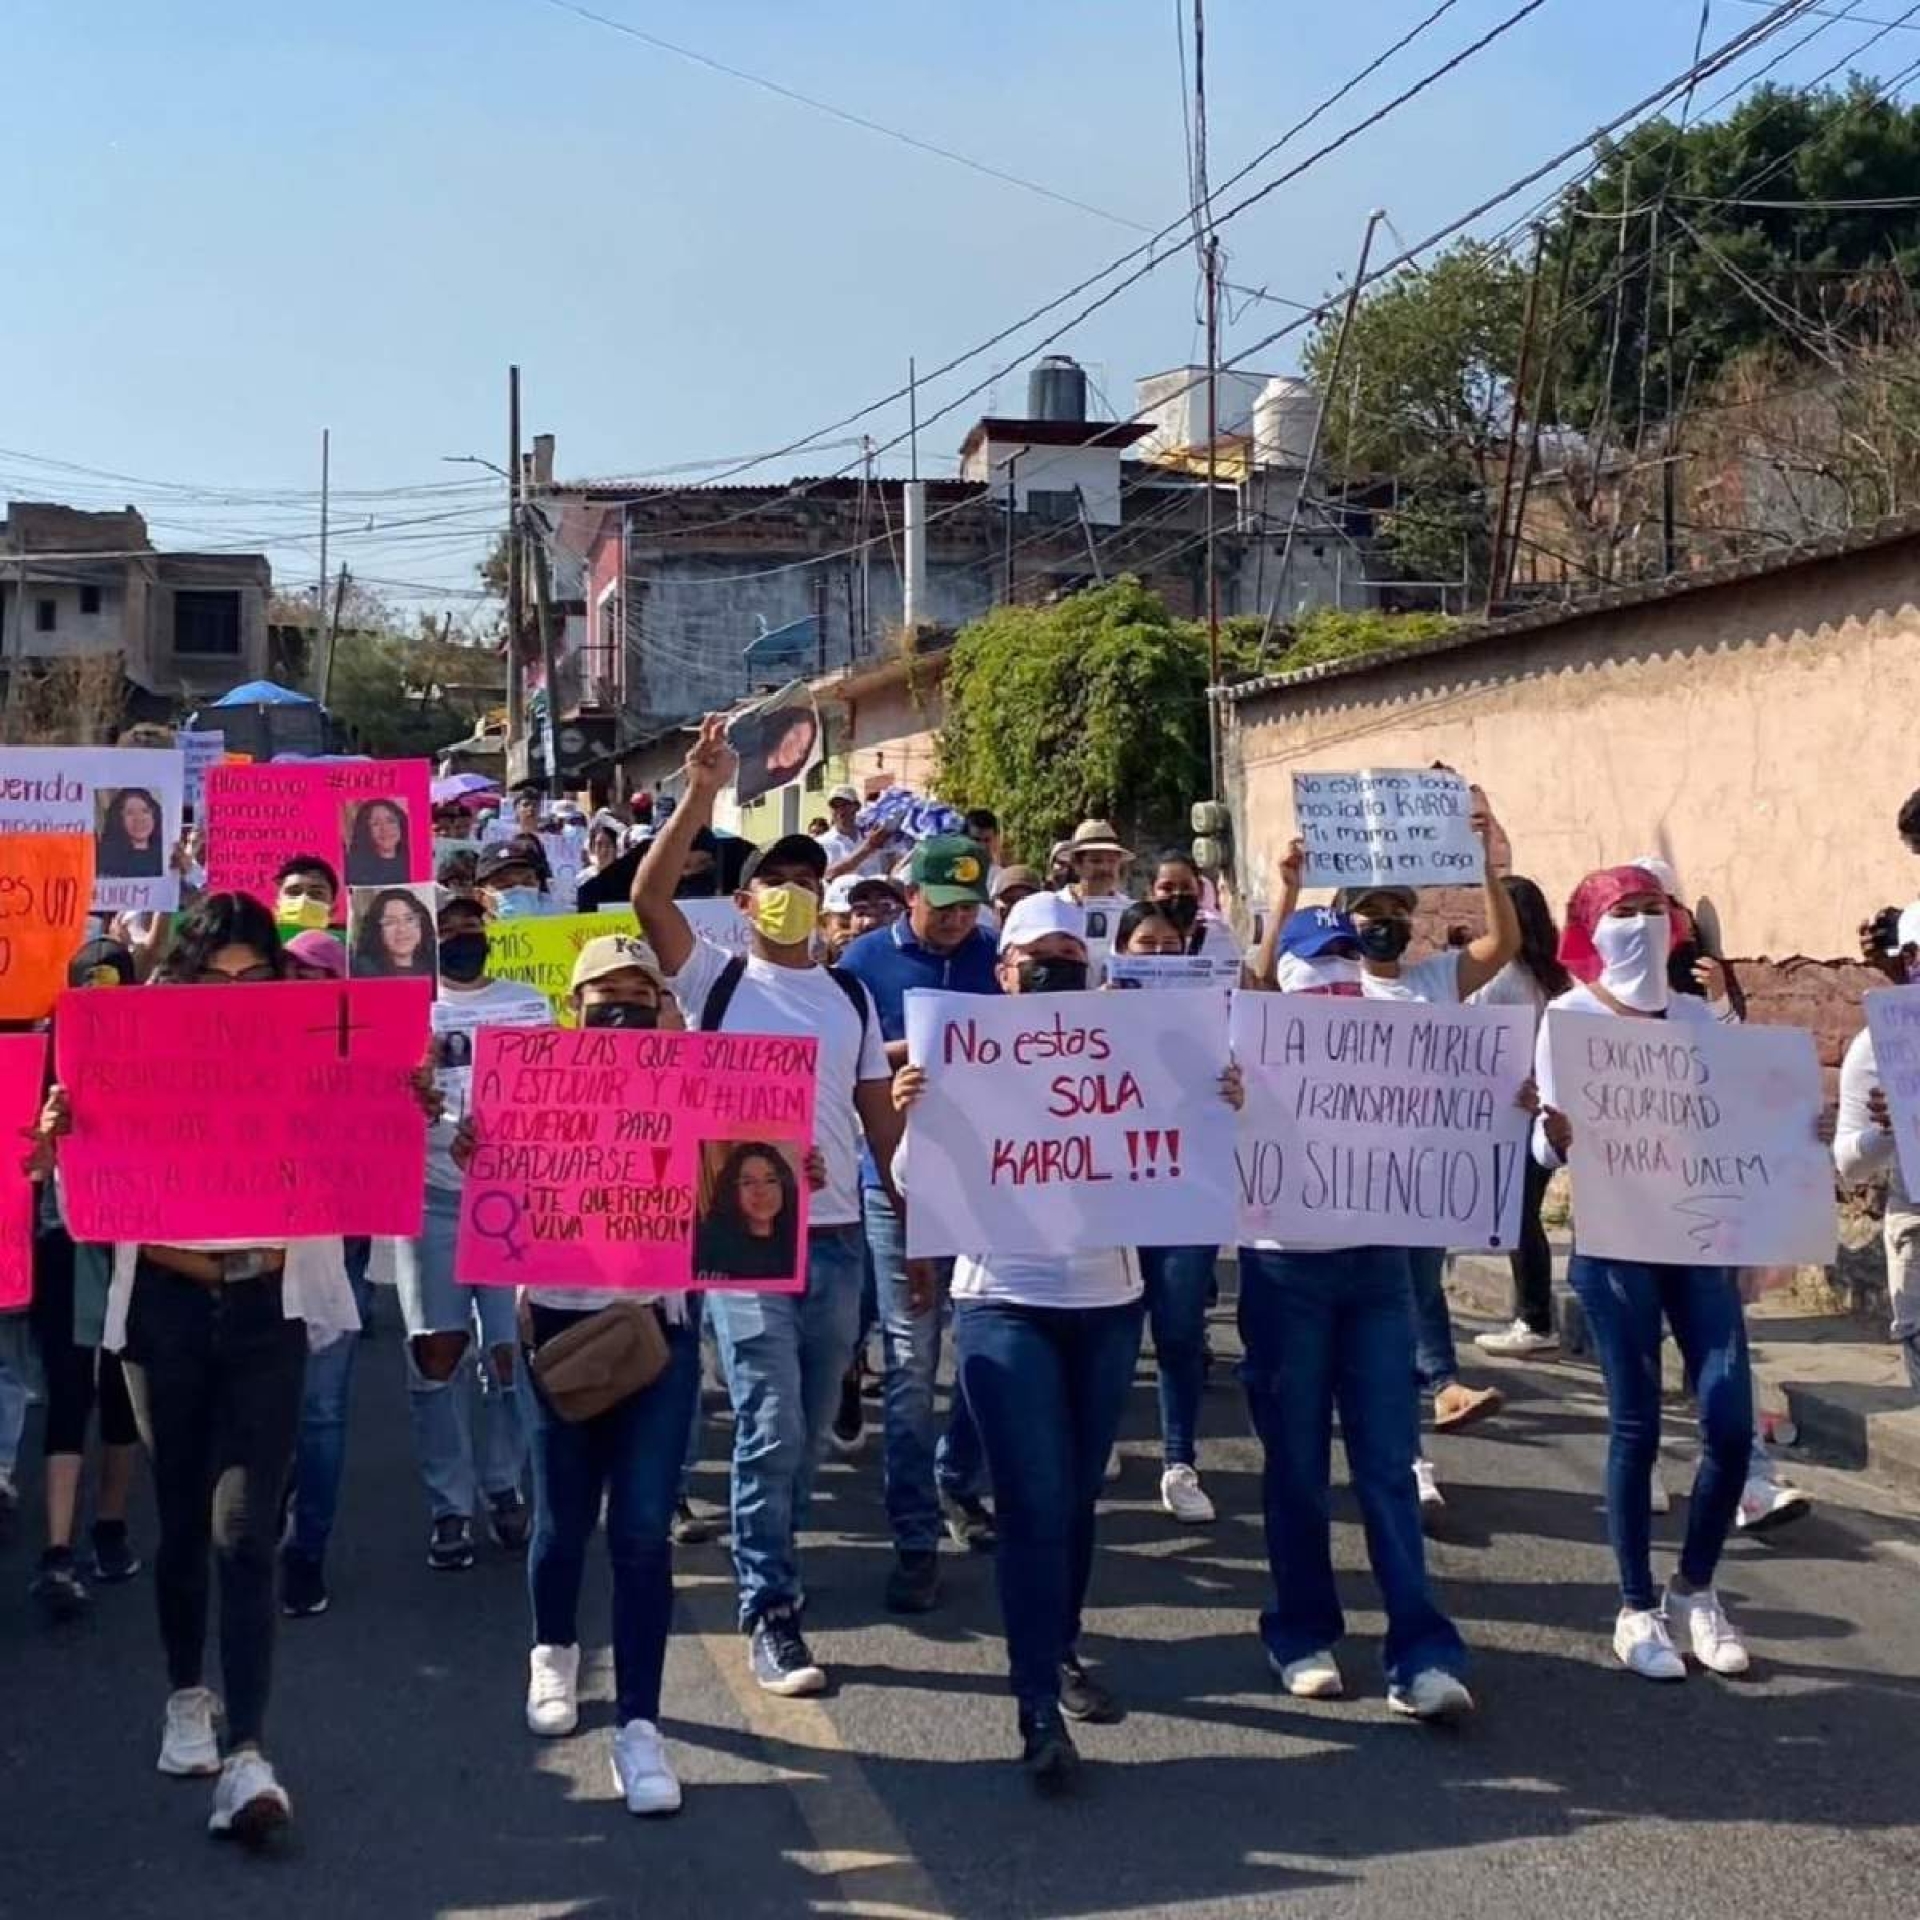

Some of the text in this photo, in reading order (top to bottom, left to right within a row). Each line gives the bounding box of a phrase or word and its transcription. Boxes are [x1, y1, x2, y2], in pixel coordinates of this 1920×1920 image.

[1294, 774, 1321, 793] No
[491, 1031, 818, 1076] POR LAS QUE SALIERON
[943, 1011, 1112, 1066] No estas
[1259, 1003, 1306, 1067] LA
[1586, 1037, 1711, 1085] EXIGIMOS
[481, 1068, 501, 1102] A
[511, 1068, 628, 1105] ESTUDIAR
[650, 1069, 666, 1105] Y
[679, 1075, 707, 1108] NO
[713, 1083, 806, 1122] #UAEM
[1048, 1071, 1145, 1118] SOLA
[1582, 1086, 1721, 1129] SEGURIDAD
[477, 1108, 672, 1142] VOLVIERON PARA
[470, 1145, 638, 1183] GRADUARSE
[991, 1135, 1113, 1186] KAROL
[1604, 1139, 1771, 1188] PARA UAEM
[578, 1184, 692, 1215] QUEREMOS
[530, 1215, 583, 1241] VIVA
